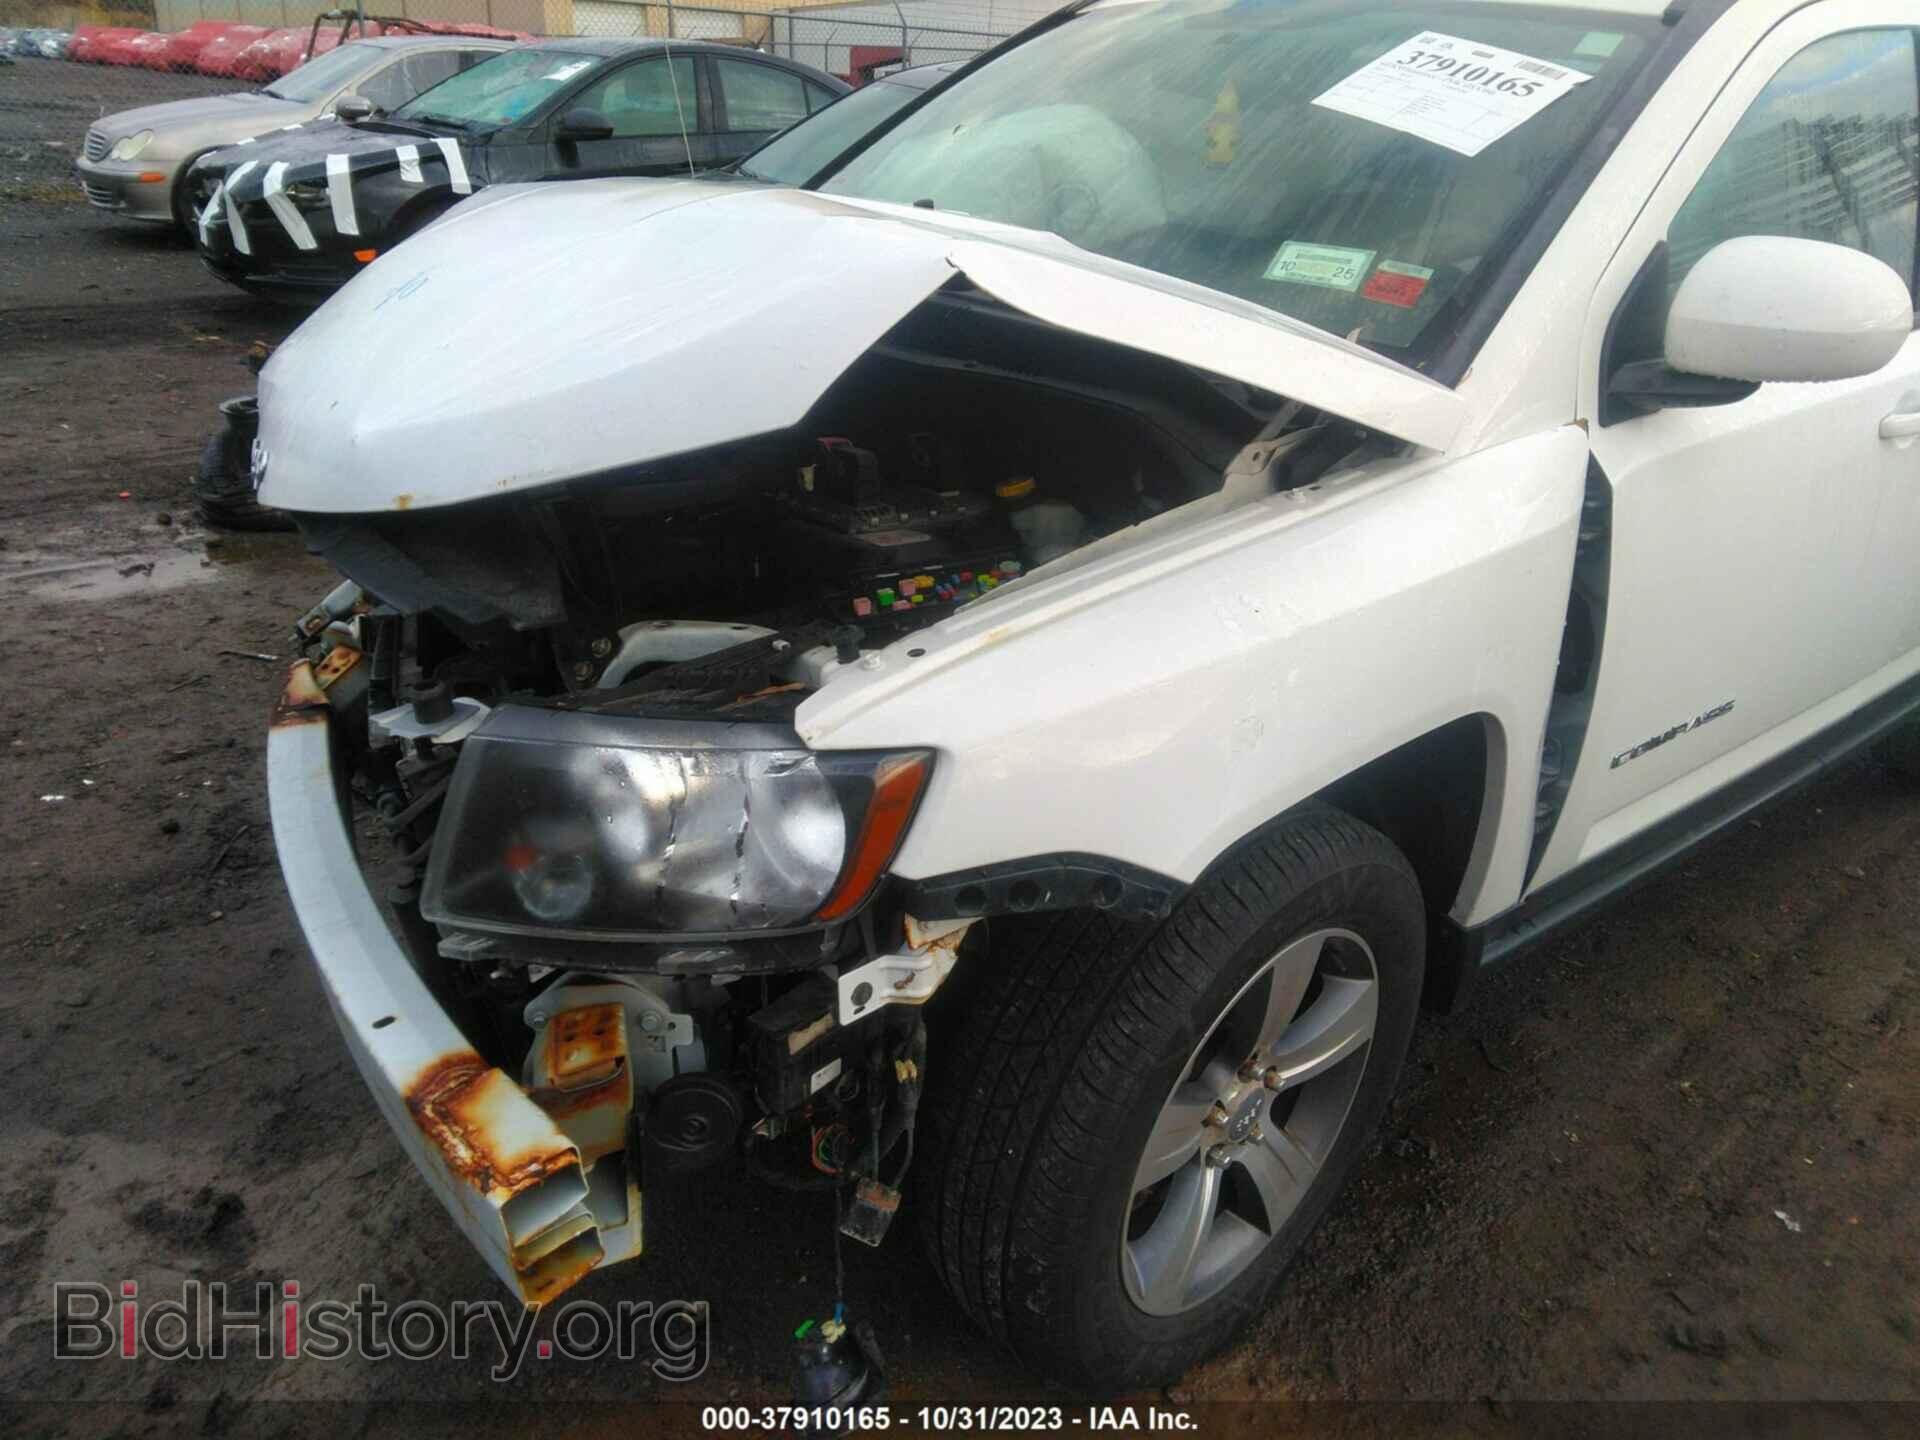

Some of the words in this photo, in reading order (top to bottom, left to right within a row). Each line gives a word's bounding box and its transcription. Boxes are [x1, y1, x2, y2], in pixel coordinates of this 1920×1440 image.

[1396, 50, 1544, 98] 37910165
[1279, 260, 1297, 272] 10
[1332, 266, 1355, 280] 25
